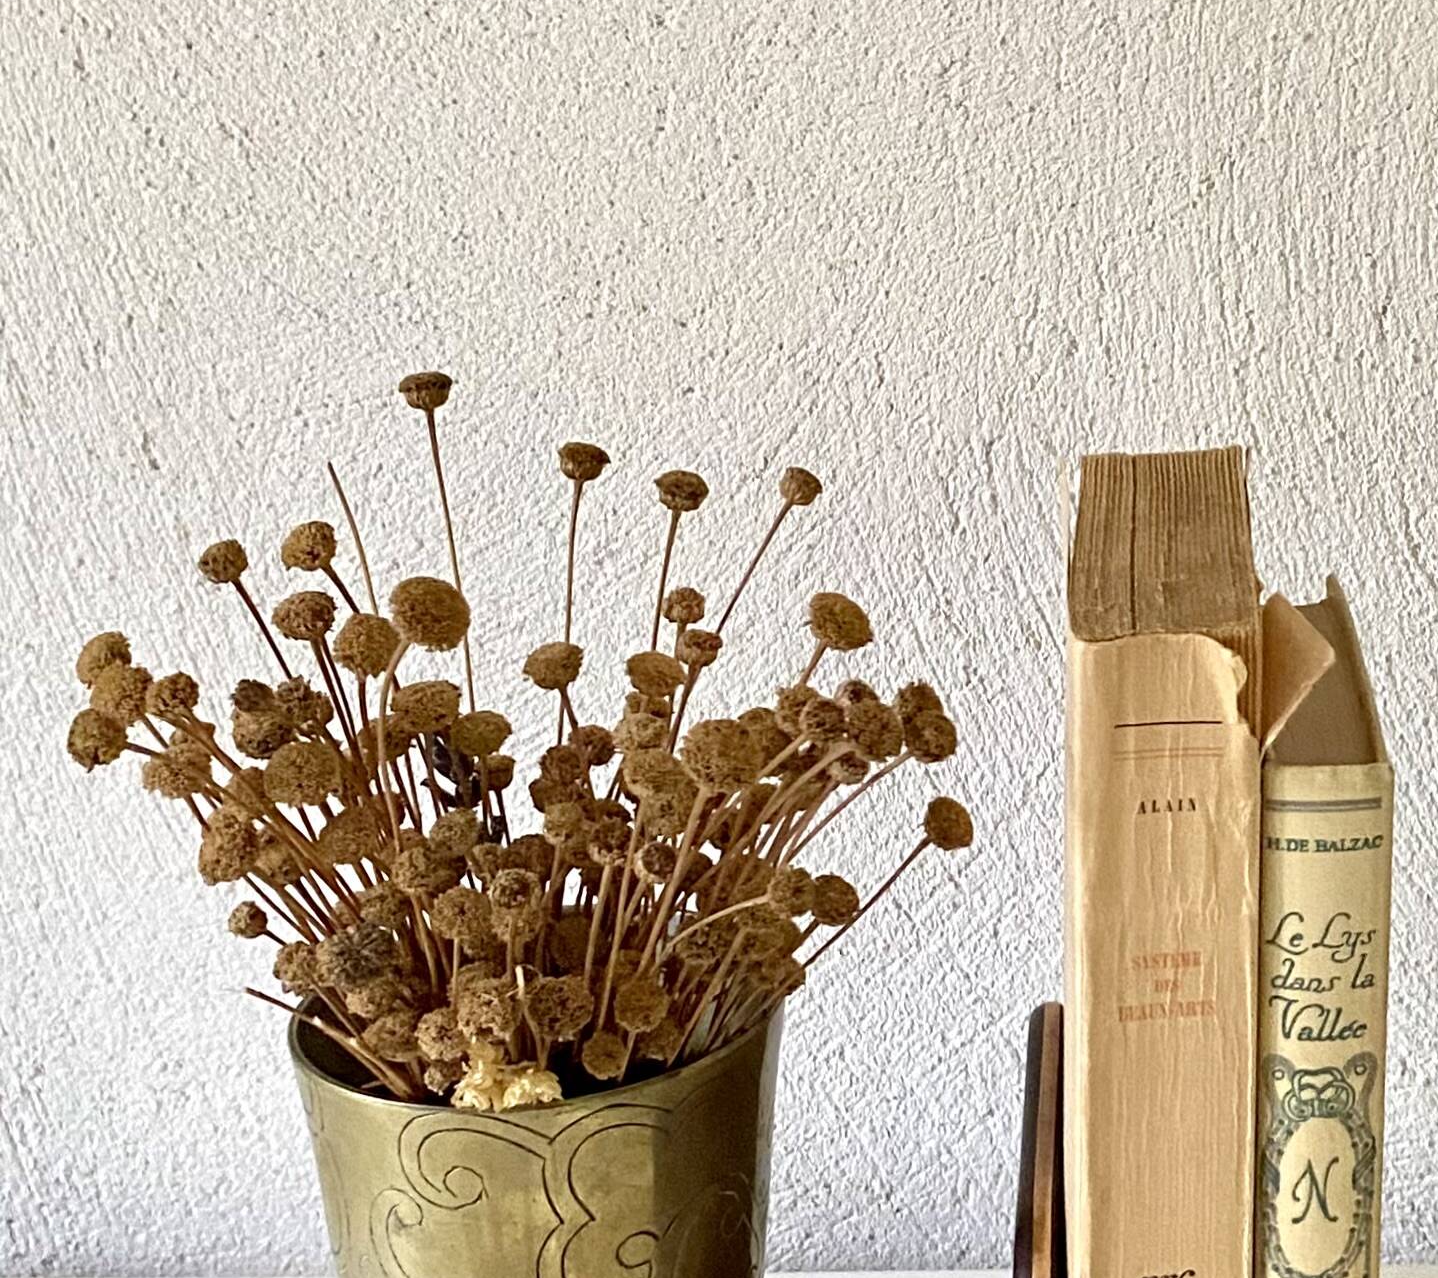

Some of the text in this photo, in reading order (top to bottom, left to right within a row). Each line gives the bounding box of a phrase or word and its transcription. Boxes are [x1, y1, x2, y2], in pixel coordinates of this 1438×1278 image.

[1137, 797, 1198, 815] ALAIN
[1314, 834, 1384, 853] BALZAC
[1265, 911, 1377, 964] Le Lys
[1270, 953, 1375, 994] dans la
[1268, 995, 1368, 1042] Vallée
[1291, 1155, 1340, 1225] N
